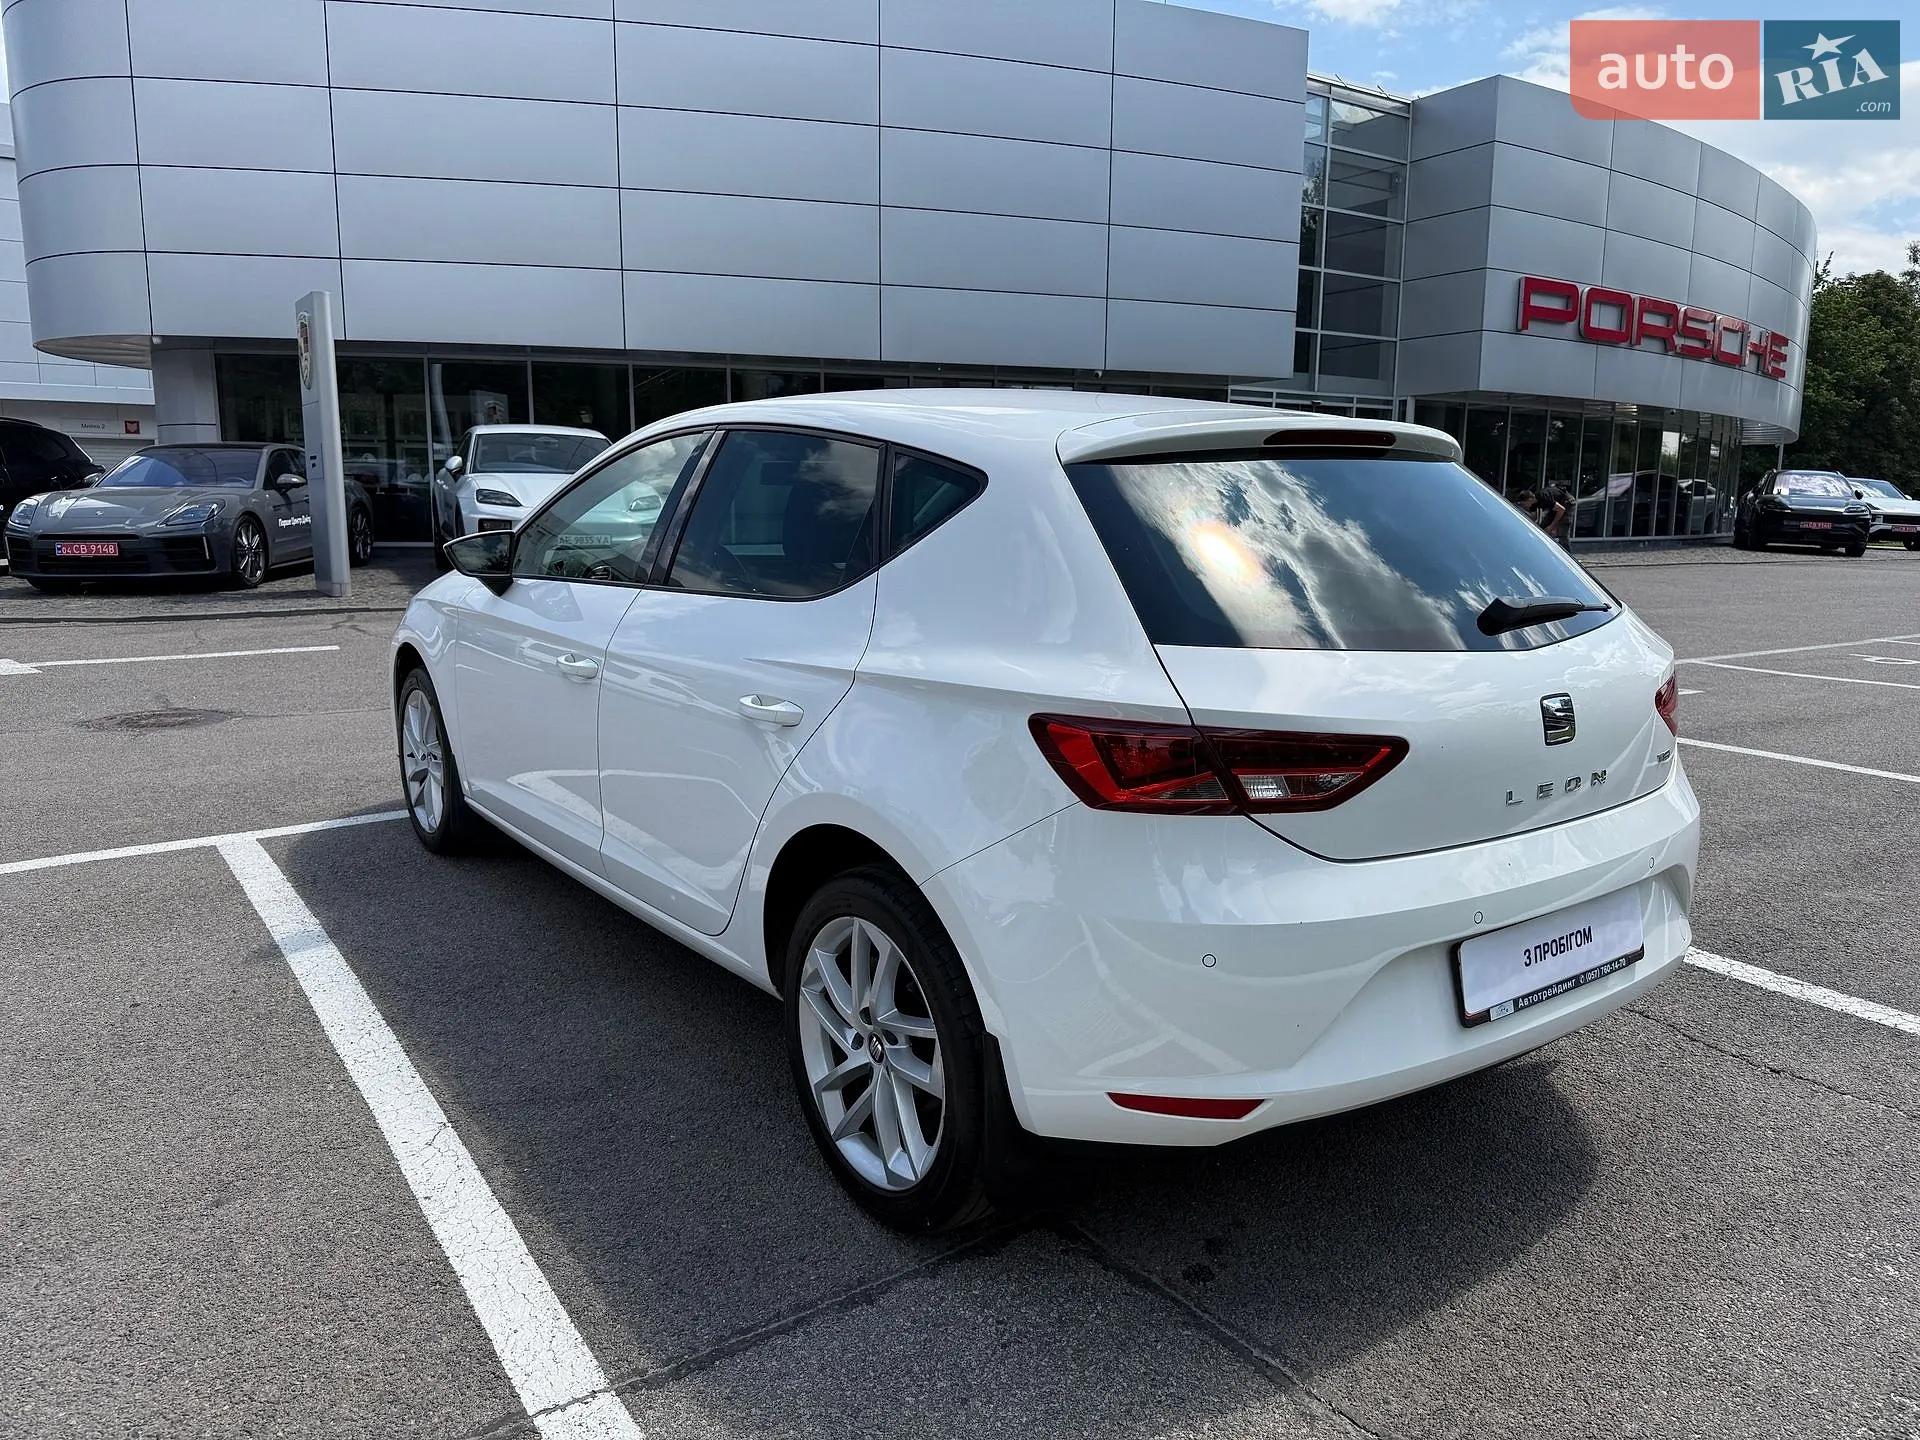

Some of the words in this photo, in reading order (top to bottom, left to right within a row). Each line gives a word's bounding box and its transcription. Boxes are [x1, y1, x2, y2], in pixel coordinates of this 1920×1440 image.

[1516, 276, 1789, 378] PORSCHE
[1505, 769, 1607, 806] LEON
[1534, 925, 1593, 964] ПРОБІГОМ
[1518, 979, 1576, 1008] Автотрейдинг
